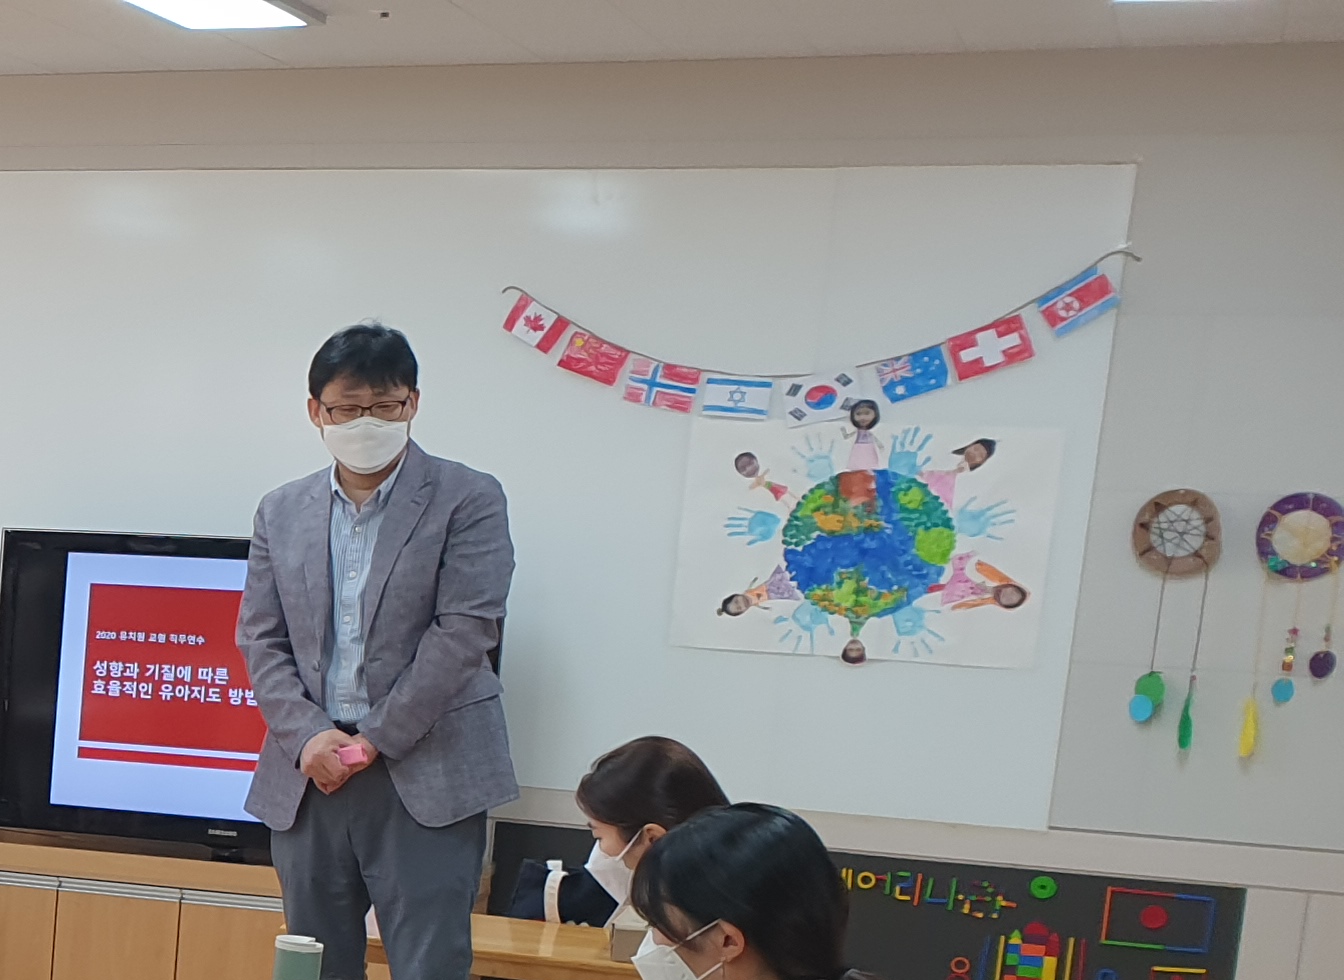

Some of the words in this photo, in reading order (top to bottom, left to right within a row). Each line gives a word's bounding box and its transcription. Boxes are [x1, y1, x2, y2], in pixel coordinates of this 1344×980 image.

[95, 630, 117, 640] 2020
[92, 660, 140, 680] 성향과
[144, 663, 192, 683] 기질에
[198, 667, 230, 685] 따른
[91, 679, 153, 699] 효율적인
[158, 684, 222, 703] 유아지도
